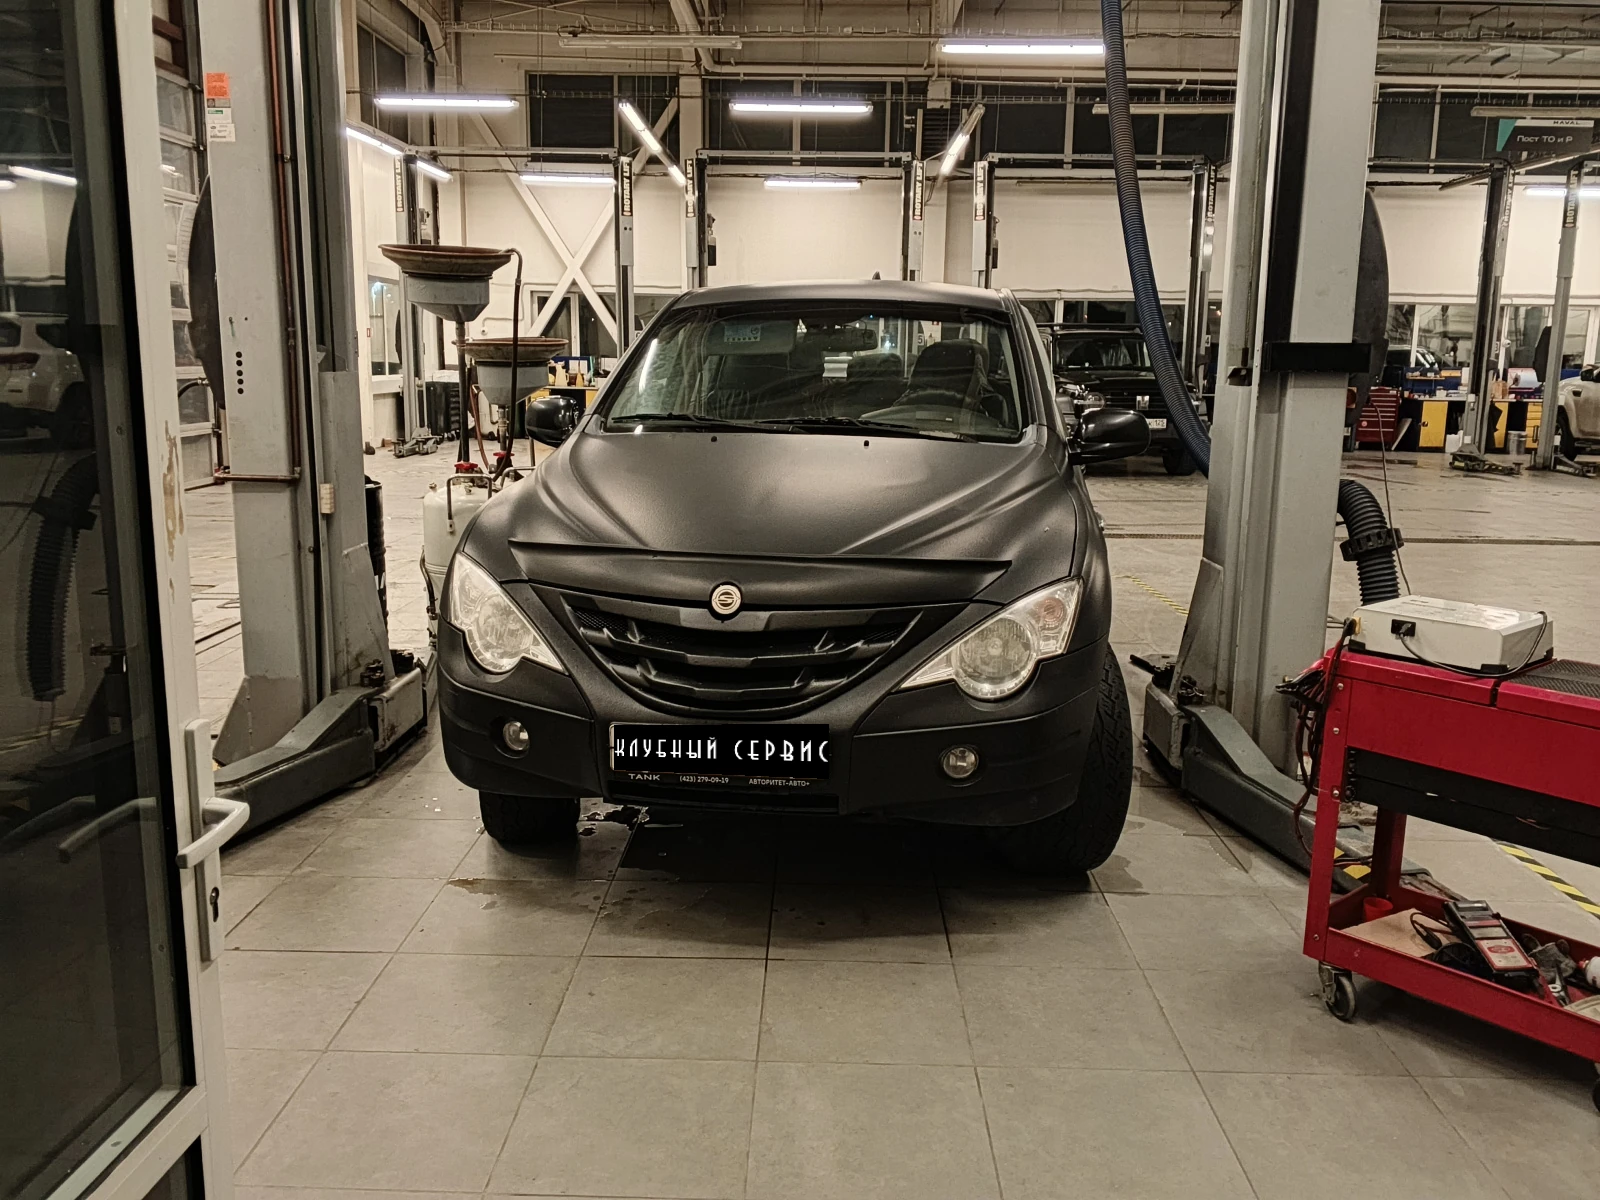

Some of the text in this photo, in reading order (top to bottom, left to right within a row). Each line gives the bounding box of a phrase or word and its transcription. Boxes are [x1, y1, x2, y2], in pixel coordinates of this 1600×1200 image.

[1542, 135, 1556, 143] ТО
[914, 181, 923, 215] ROTARY
[1207, 184, 1215, 217] ROTARY
[628, 773, 661, 781] TANK
[679, 775, 729, 784] (423) 279-09-19
[748, 778, 810, 787] АВТОРИТЕТ-АВТО+
